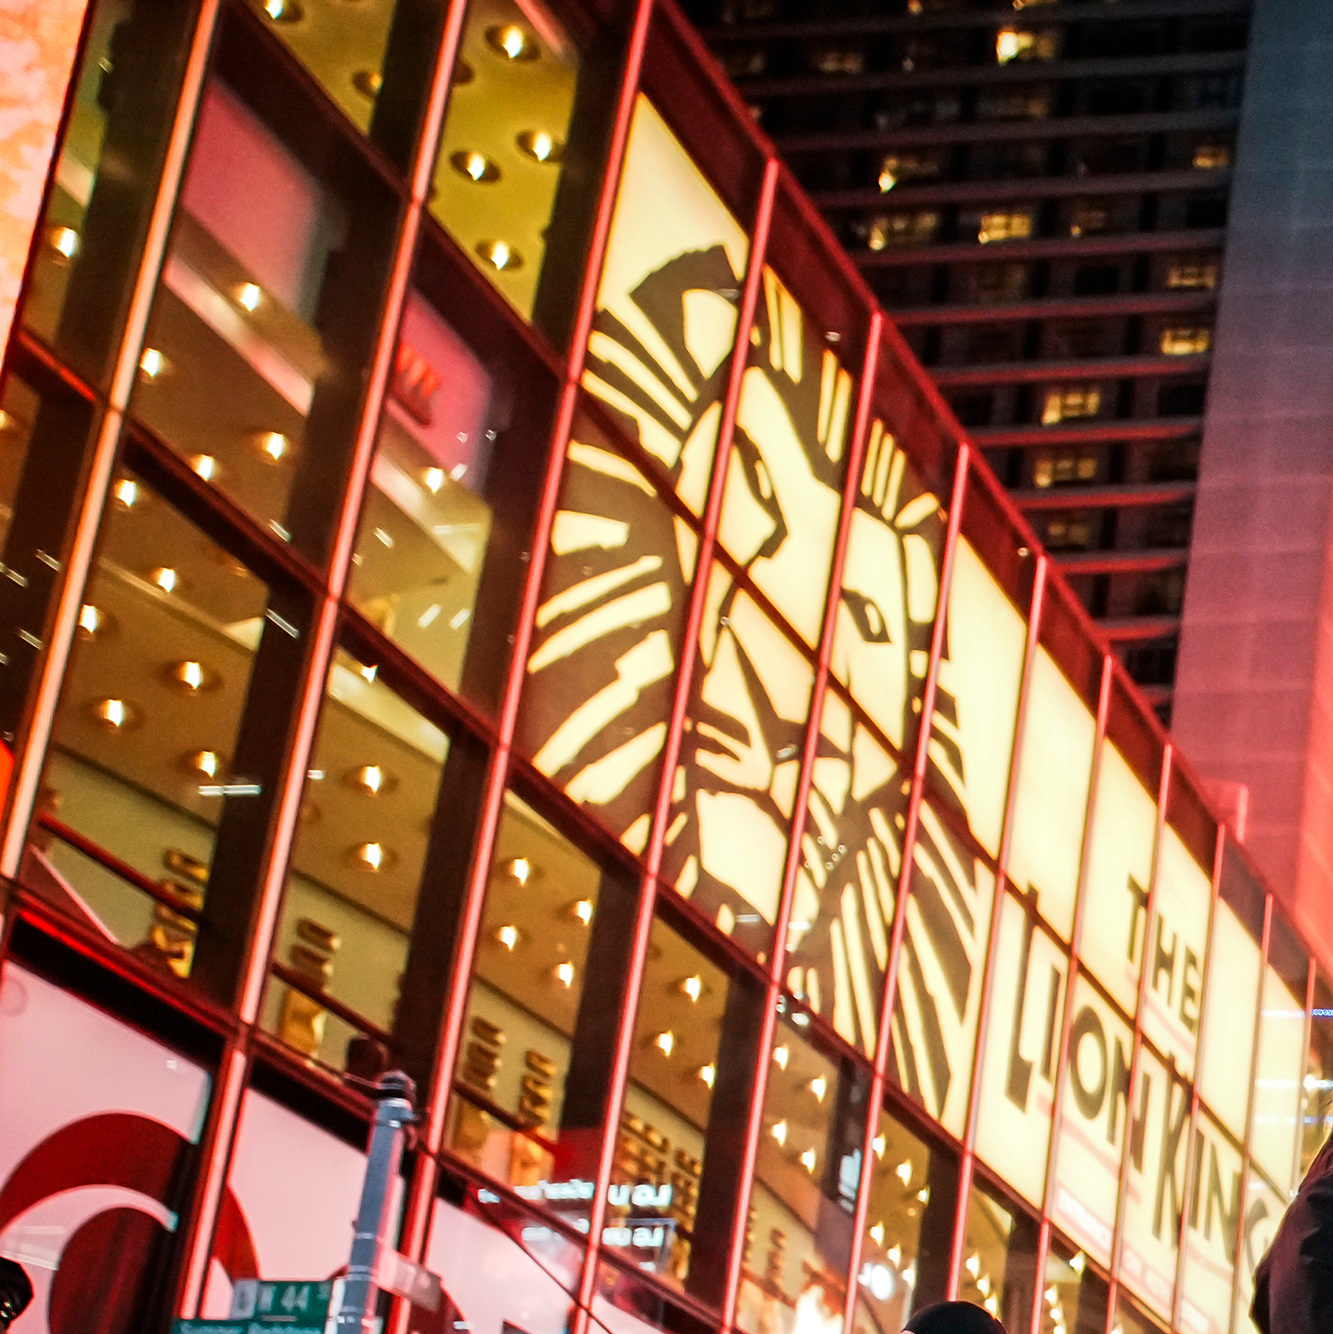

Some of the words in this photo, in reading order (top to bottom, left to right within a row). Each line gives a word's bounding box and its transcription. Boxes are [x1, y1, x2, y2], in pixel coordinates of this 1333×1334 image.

[1005, 882, 1151, 1173] LION
[1127, 874, 1201, 1034] THE
[281, 1284, 311, 1312] 44
